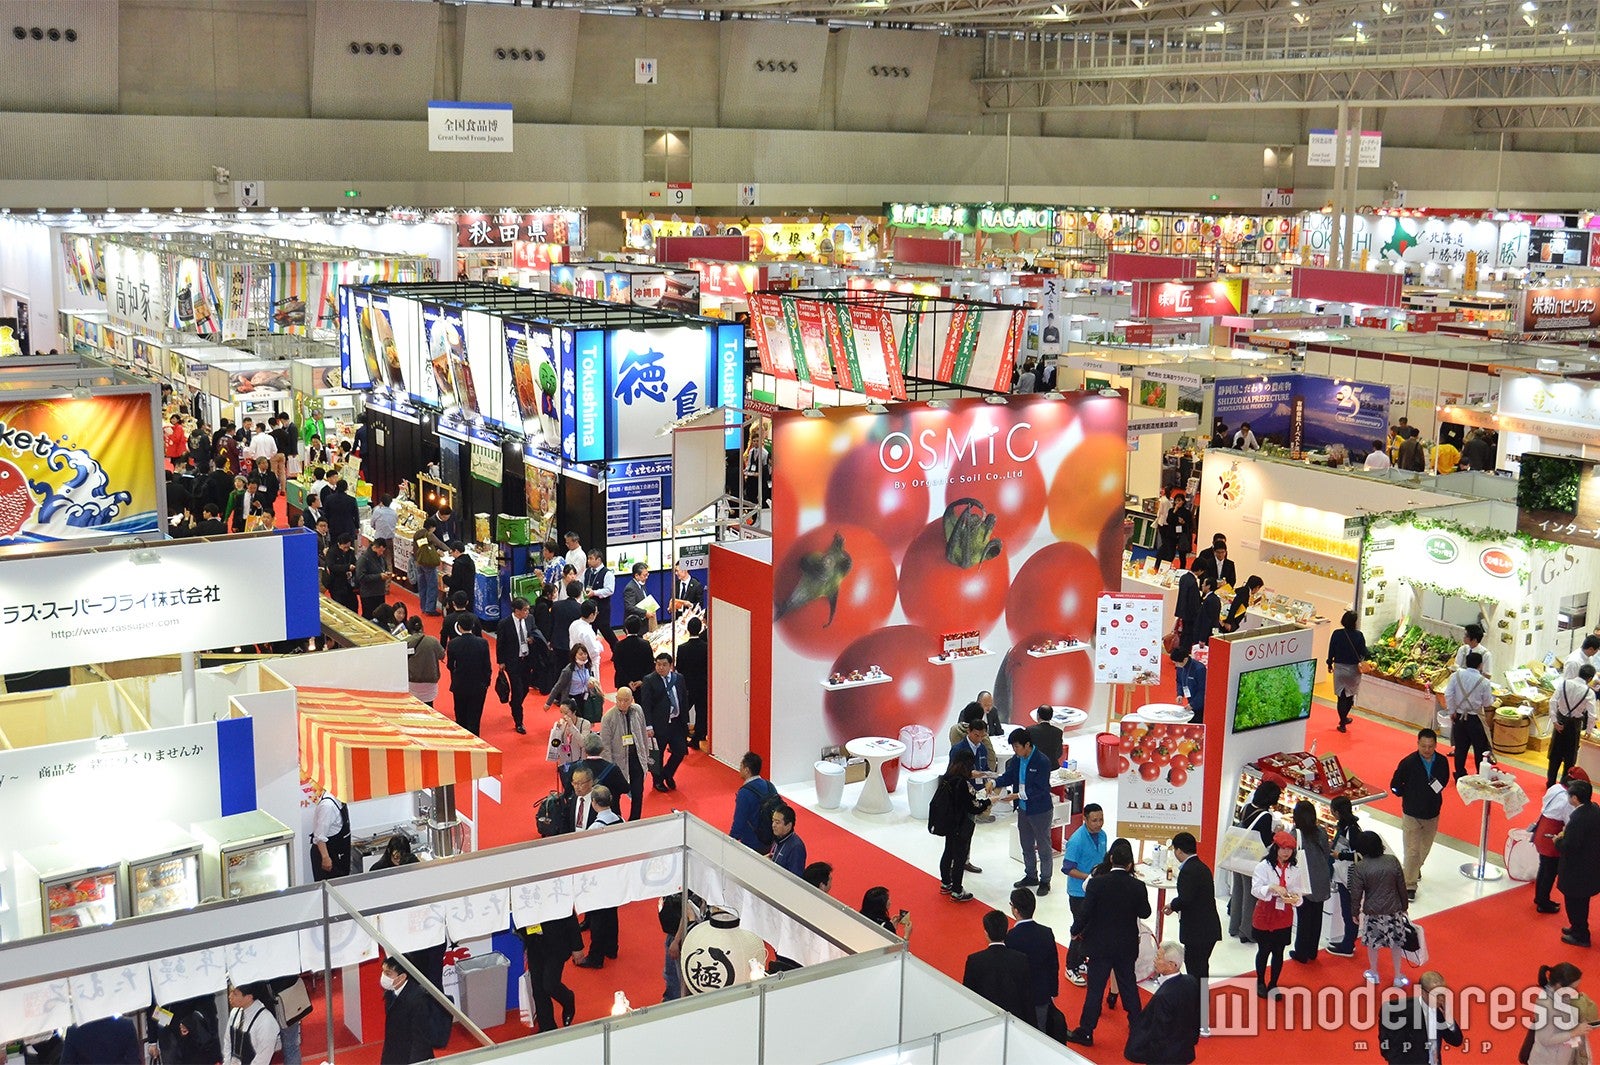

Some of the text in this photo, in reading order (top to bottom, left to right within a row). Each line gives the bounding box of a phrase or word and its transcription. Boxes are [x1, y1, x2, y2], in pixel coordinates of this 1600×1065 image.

[444, 118, 498, 132] 全国食品博
[675, 190, 684, 204] 9
[1280, 195, 1291, 206] 10
[492, 215, 523, 224] AKITA
[980, 210, 1046, 228] NAGANO
[468, 219, 547, 246] 秋田県
[1428, 232, 1464, 248] 北海道
[1428, 249, 1491, 264] 十勝物館
[115, 273, 151, 323] 高知家
[232, 271, 244, 312] 高知家
[633, 288, 661, 298] 沖縄県
[1158, 284, 1194, 313] 味の匠
[852, 311, 872, 319] TOTTORI
[614, 346, 701, 421] 徳島
[723, 338, 738, 436] Tokushima
[1218, 382, 1292, 395] 静岡県こだわりの農産物
[582, 344, 599, 448] Tokushima
[1339, 385, 1364, 417] 25
[894, 480, 906, 490] By
[911, 476, 955, 488] Organic
[959, 474, 981, 484] Soil
[685, 558, 704, 567] 9E70
[3, 584, 221, 624] ラス・スーパーフライ株式会社
[50, 617, 180, 639] http://www.rassuper.com
[691, 961, 722, 989] 極
